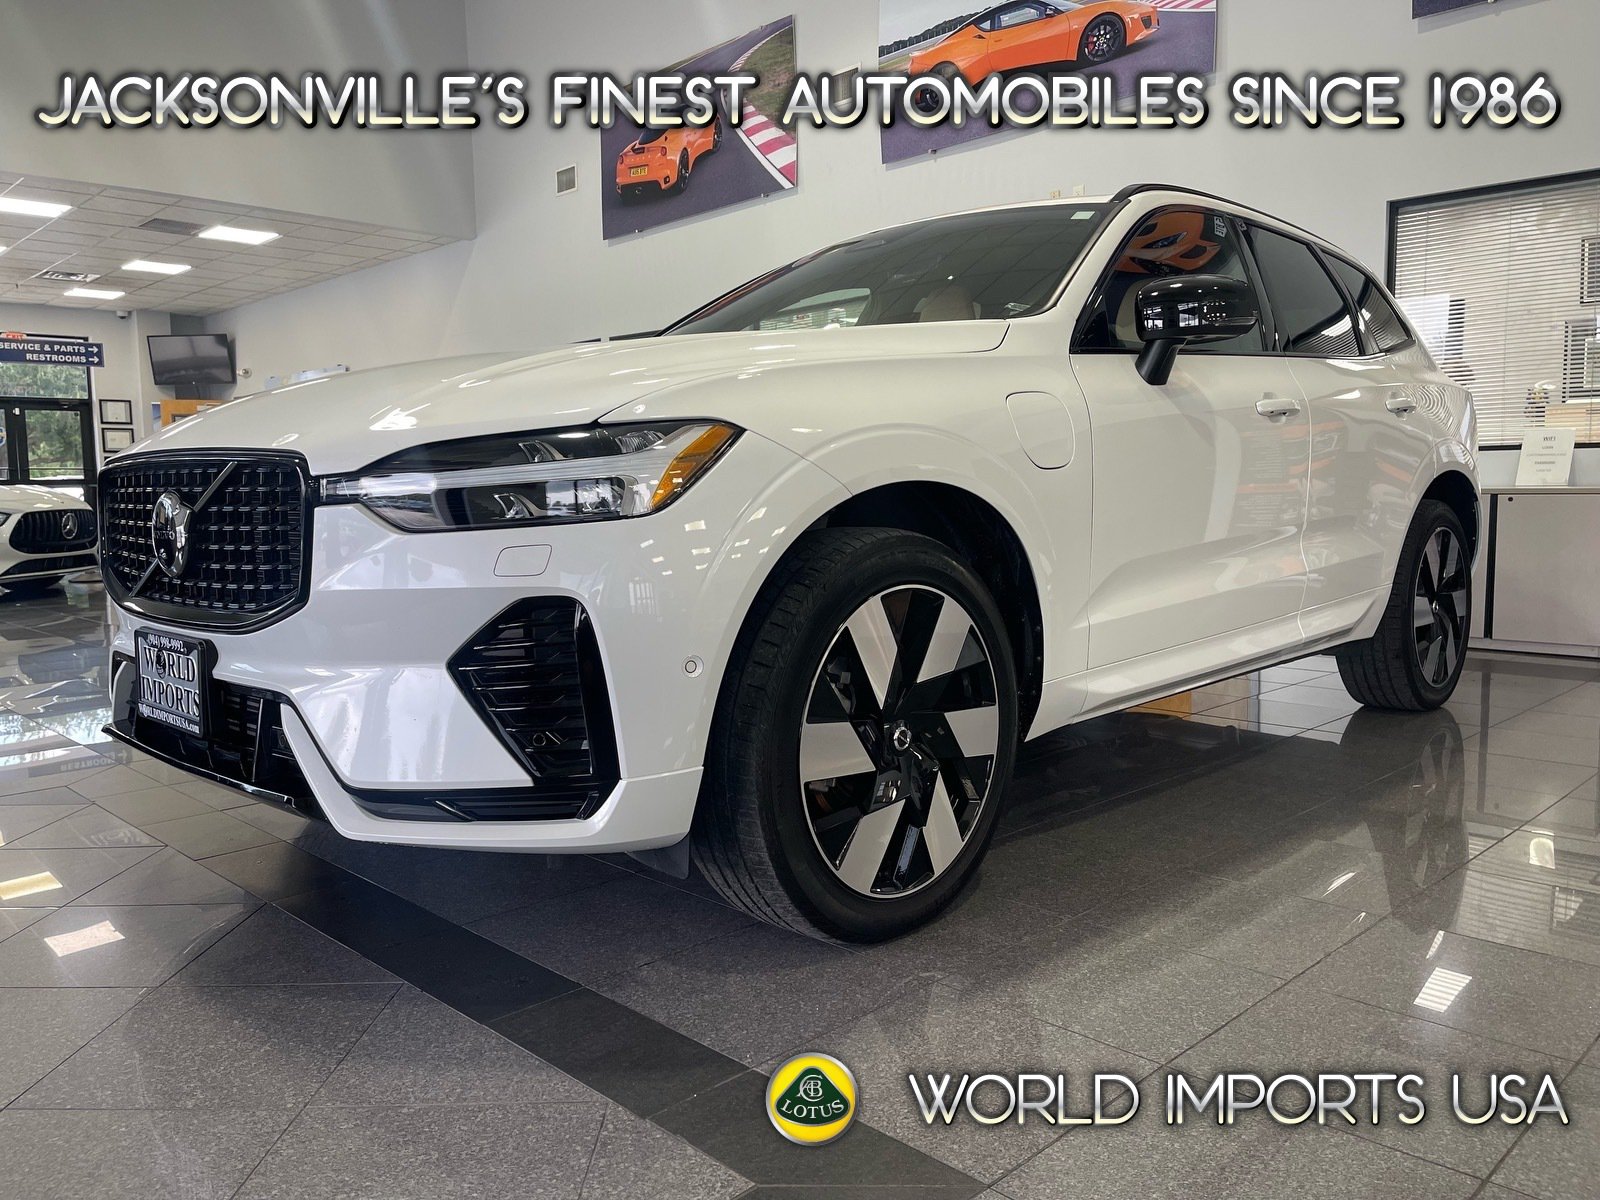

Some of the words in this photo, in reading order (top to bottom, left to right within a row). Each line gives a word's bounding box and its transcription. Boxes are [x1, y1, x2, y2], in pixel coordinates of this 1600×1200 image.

[0, 342, 41, 351] SERVICE
[54, 345, 86, 353] PARTS
[26, 353, 87, 363] RESTROOMS
[144, 645, 197, 682] WORLD
[140, 674, 200, 717] IMPORTS
